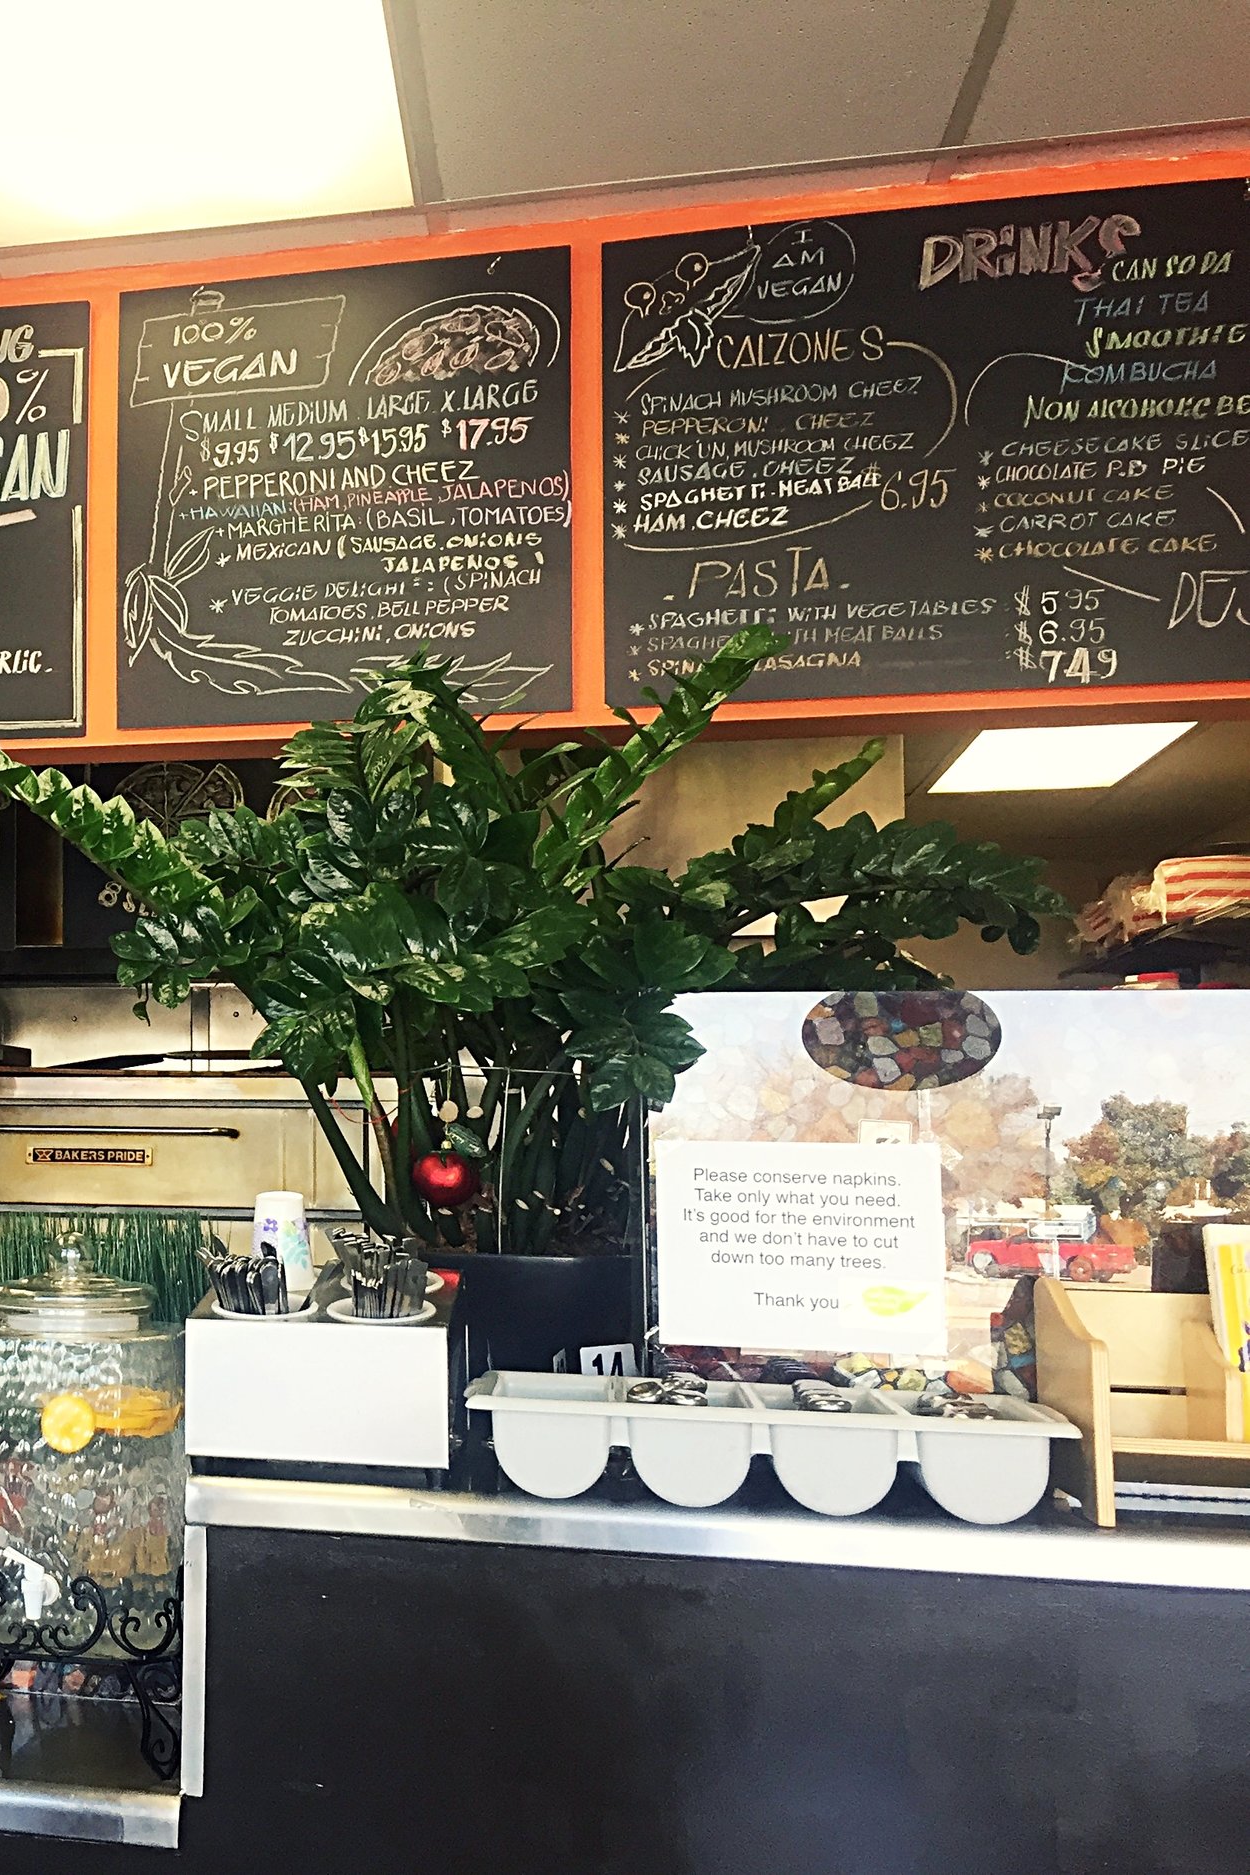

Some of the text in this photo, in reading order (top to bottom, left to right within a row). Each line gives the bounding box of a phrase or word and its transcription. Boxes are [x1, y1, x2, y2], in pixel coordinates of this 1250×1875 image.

[790, 228, 815, 245] I
[772, 249, 825, 270] AM
[1112, 256, 1158, 283] CAN
[757, 272, 842, 300] VEGAN
[1158, 290, 1210, 315] TEA
[172, 316, 258, 348] 100%
[162, 348, 299, 390] VEGAN
[1060, 359, 1218, 395] KOMBUCHA
[729, 375, 923, 409] MUSHROOM CHEEZ
[179, 408, 259, 442] SMALL
[366, 390, 432, 419] LARGE
[794, 411, 876, 432] CHEEZ
[1023, 394, 1080, 429] NON
[199, 416, 535, 469] $9.95 $12.95 $17.95
[733, 432, 916, 460] MUSHROOM CHEEZ
[762, 456, 857, 478] CHEEZ
[995, 461, 1098, 484] CHOCOLATE
[202, 459, 482, 501] PEPPERONI AND CHEEZ
[994, 484, 1176, 508] COCONUT CAKE
[633, 505, 790, 534] HAM CHEEZ
[999, 508, 1177, 533] CARROT CAKE
[998, 533, 1219, 560] CHOCOLATE CAKE
[269, 594, 511, 625] TOMATOES BELL PEPPER
[846, 598, 998, 622] VEGETABLES
[54, 1149, 144, 1162] BAKERS PRIDE
[693, 1167, 902, 1189] Please conserve napkins.
[694, 1187, 902, 1210] Take only what you need.
[683, 1207, 916, 1230] It's good for the environment
[699, 1229, 900, 1250] and we don't have to cut
[710, 1249, 887, 1271] down too many trees.
[753, 1291, 840, 1312] Thank you
